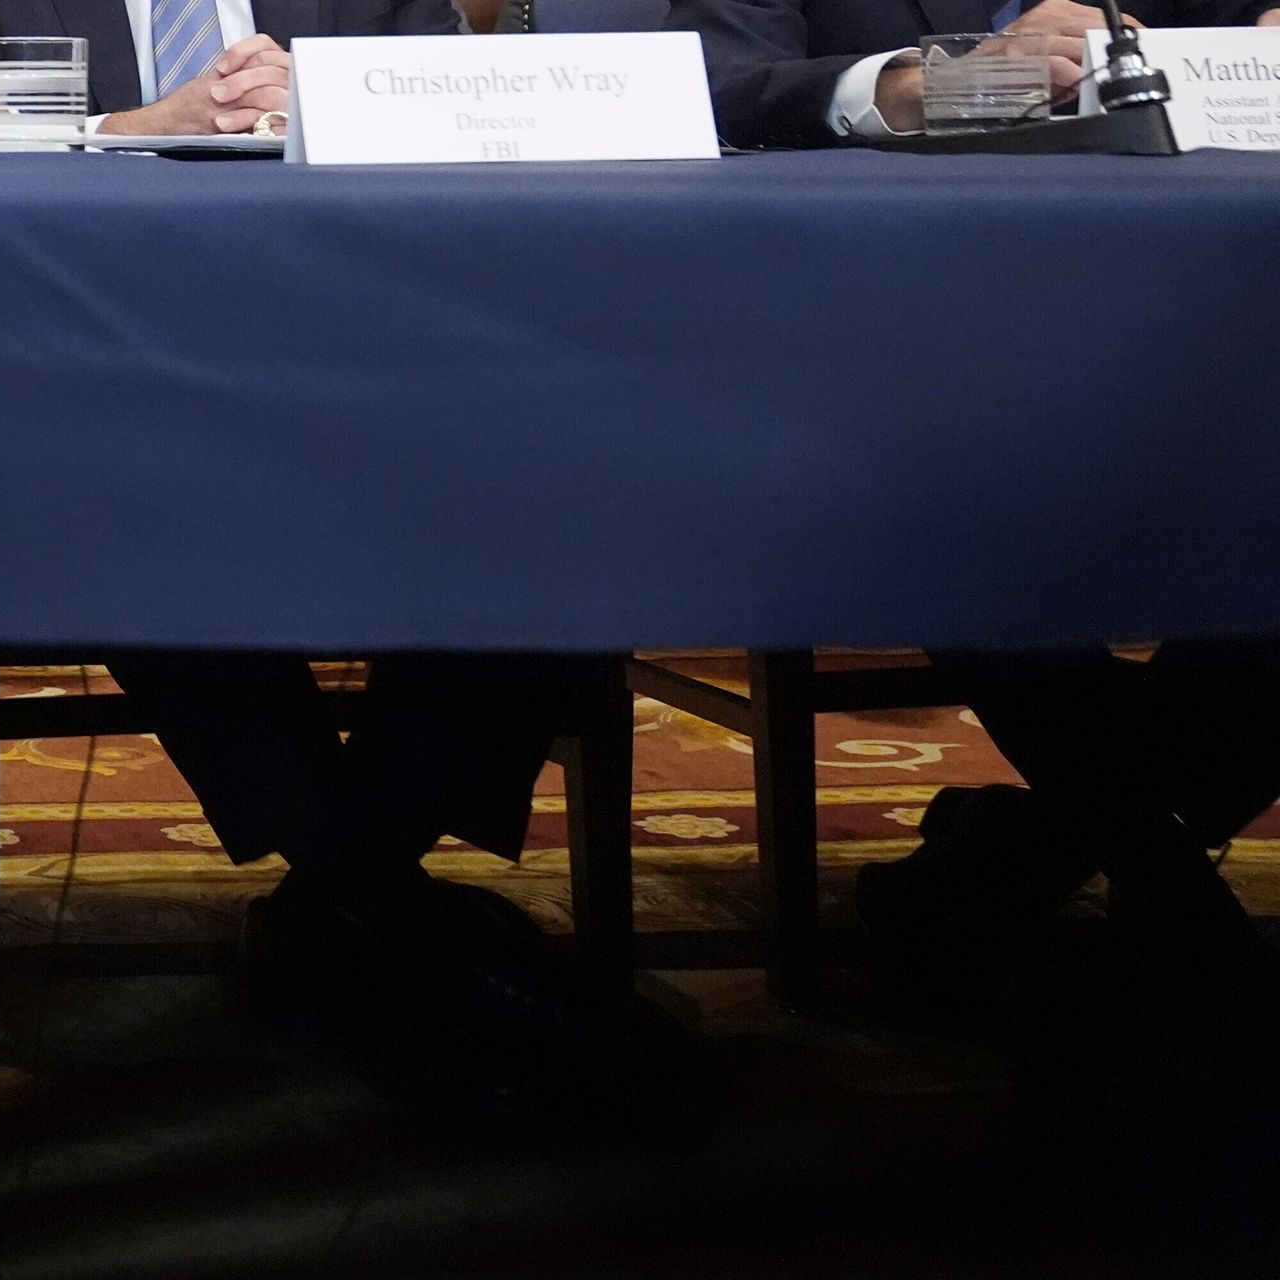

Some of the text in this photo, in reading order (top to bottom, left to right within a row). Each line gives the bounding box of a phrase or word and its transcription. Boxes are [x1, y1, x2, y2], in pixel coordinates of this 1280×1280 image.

[363, 67, 628, 101] Christopher Wray
[455, 112, 537, 130] Director
[481, 140, 521, 158] FBI
